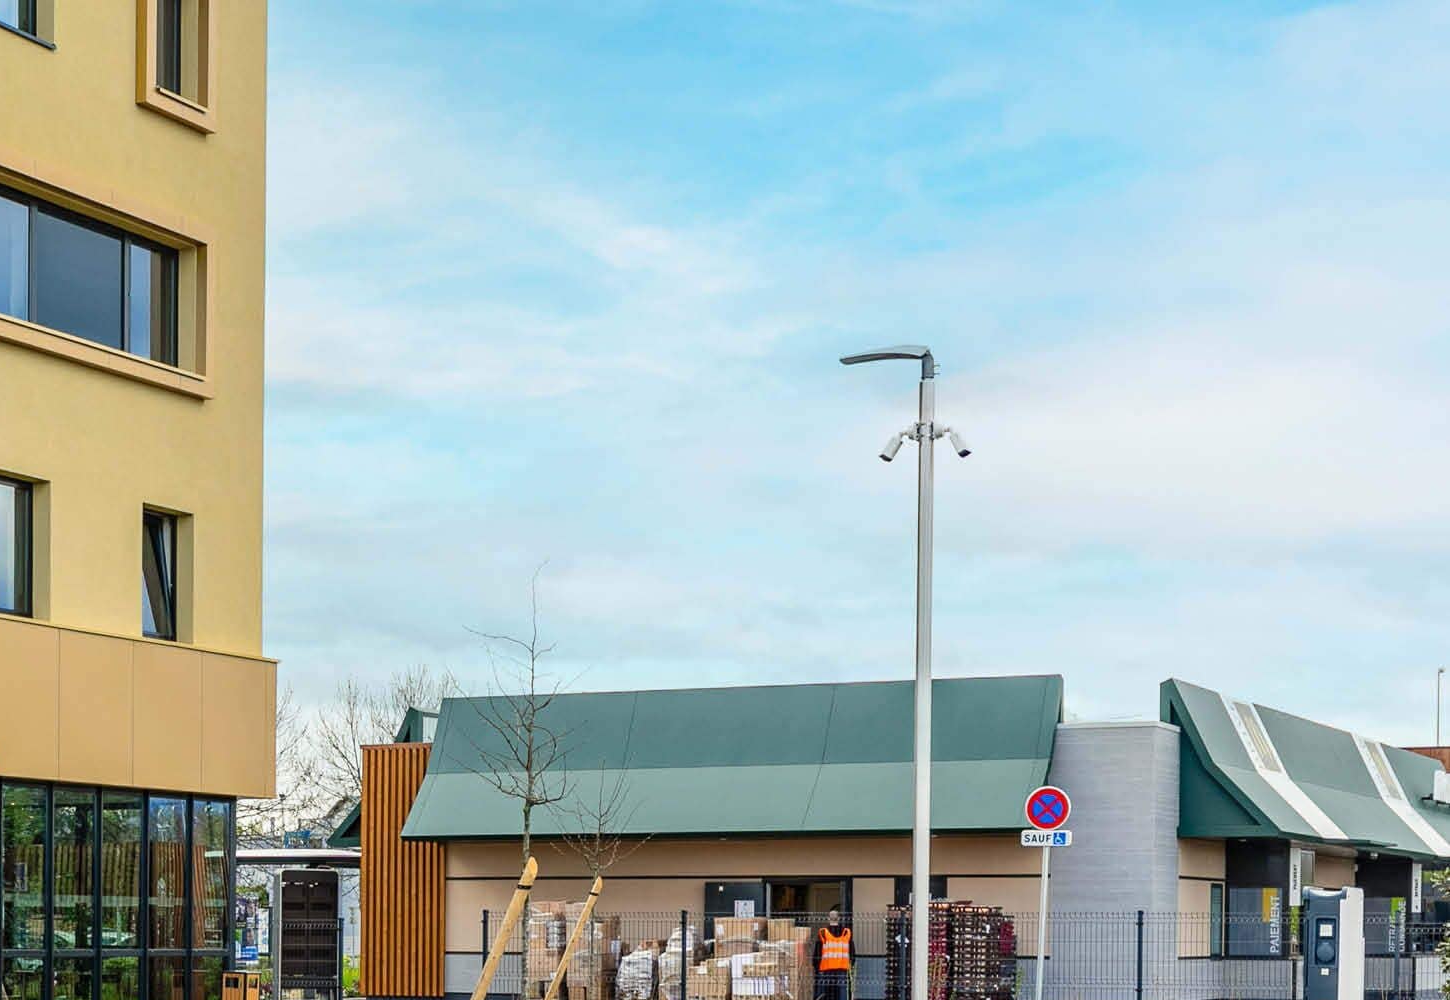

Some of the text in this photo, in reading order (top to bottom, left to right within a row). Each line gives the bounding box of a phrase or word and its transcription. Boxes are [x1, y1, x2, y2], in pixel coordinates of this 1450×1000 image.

[1024, 834, 1052, 843] SAUF
[1270, 895, 1280, 953] PAIEMENT
[1398, 900, 1406, 952] COMANDE
